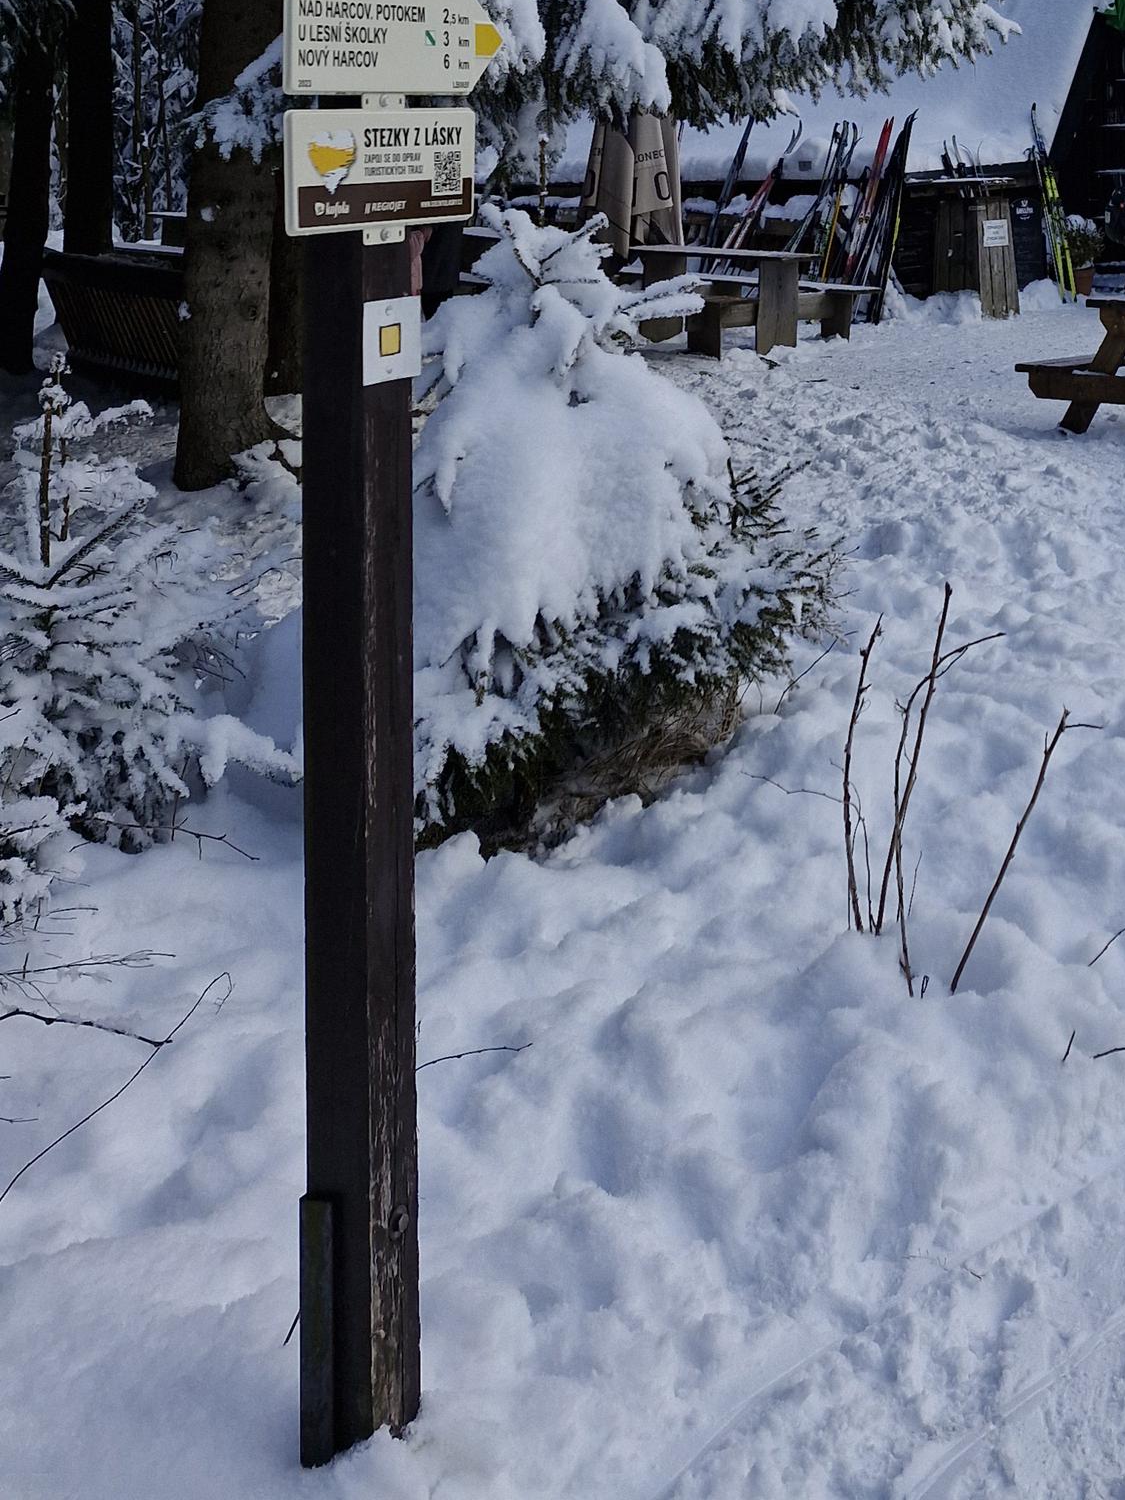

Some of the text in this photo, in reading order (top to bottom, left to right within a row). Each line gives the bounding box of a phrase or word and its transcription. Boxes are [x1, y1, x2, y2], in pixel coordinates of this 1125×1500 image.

[299, 0, 425, 23] NAD HARCOV. POTOKEM
[443, 9, 469, 25] 2,5 km
[299, 22, 387, 44] U LESNÍ ŠKOLKY
[443, 32, 469, 47] 3 km
[299, 45, 378, 68] NOVÝ HARCOV
[444, 54, 469, 70] 6 km
[364, 121, 462, 147] STEZKY Z LÁSKY
[384, 153, 391, 163] SE
[403, 153, 421, 163] OPRAV
[364, 164, 405, 177] TURISTICKÝCH
